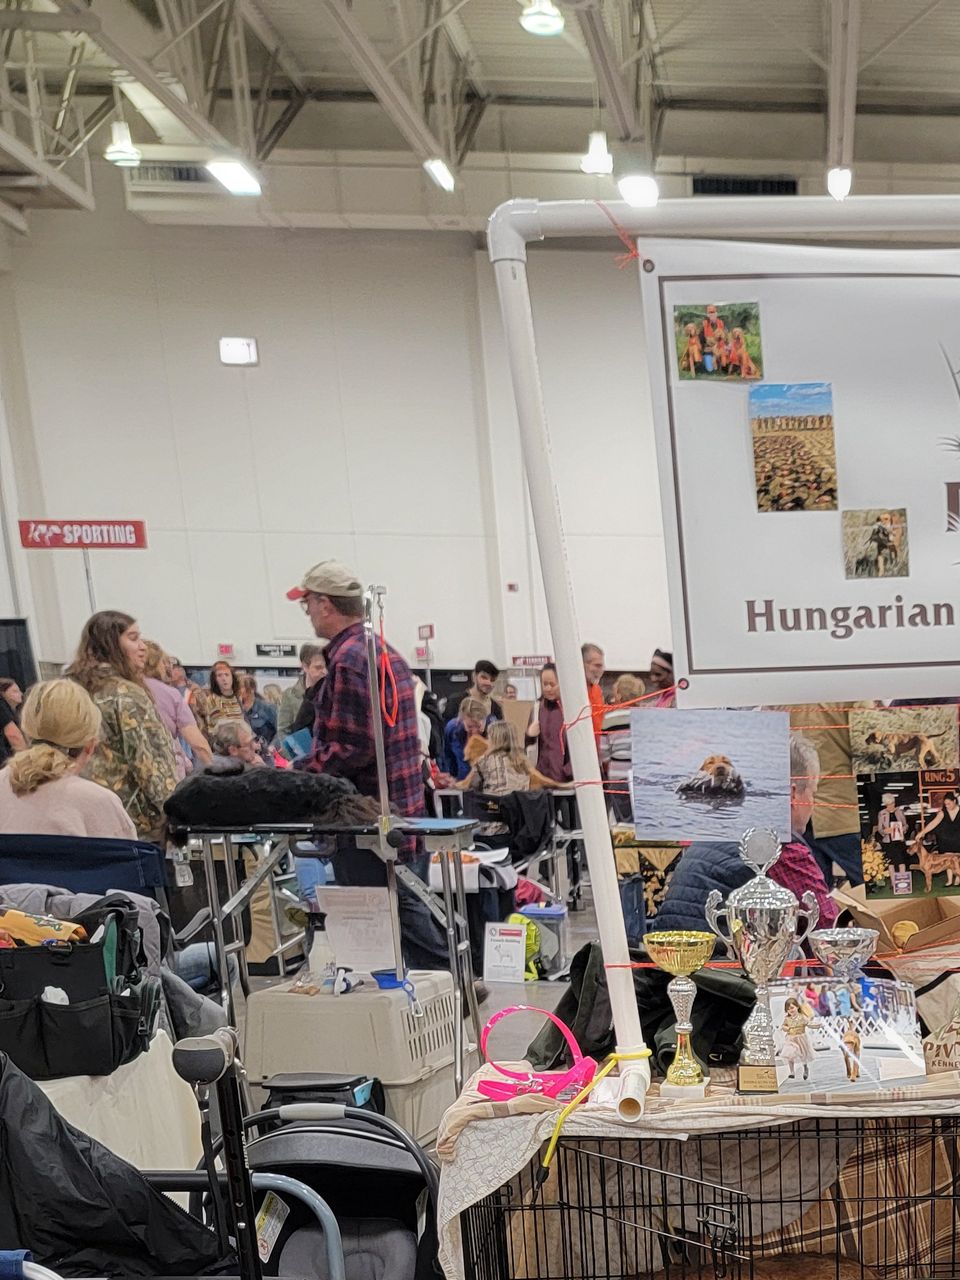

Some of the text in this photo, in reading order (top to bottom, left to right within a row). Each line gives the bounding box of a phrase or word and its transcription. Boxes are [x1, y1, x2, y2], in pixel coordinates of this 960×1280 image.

[63, 524, 136, 544] SPORTING
[746, 595, 955, 639] Hungarian
[925, 768, 956, 782] RING 5
